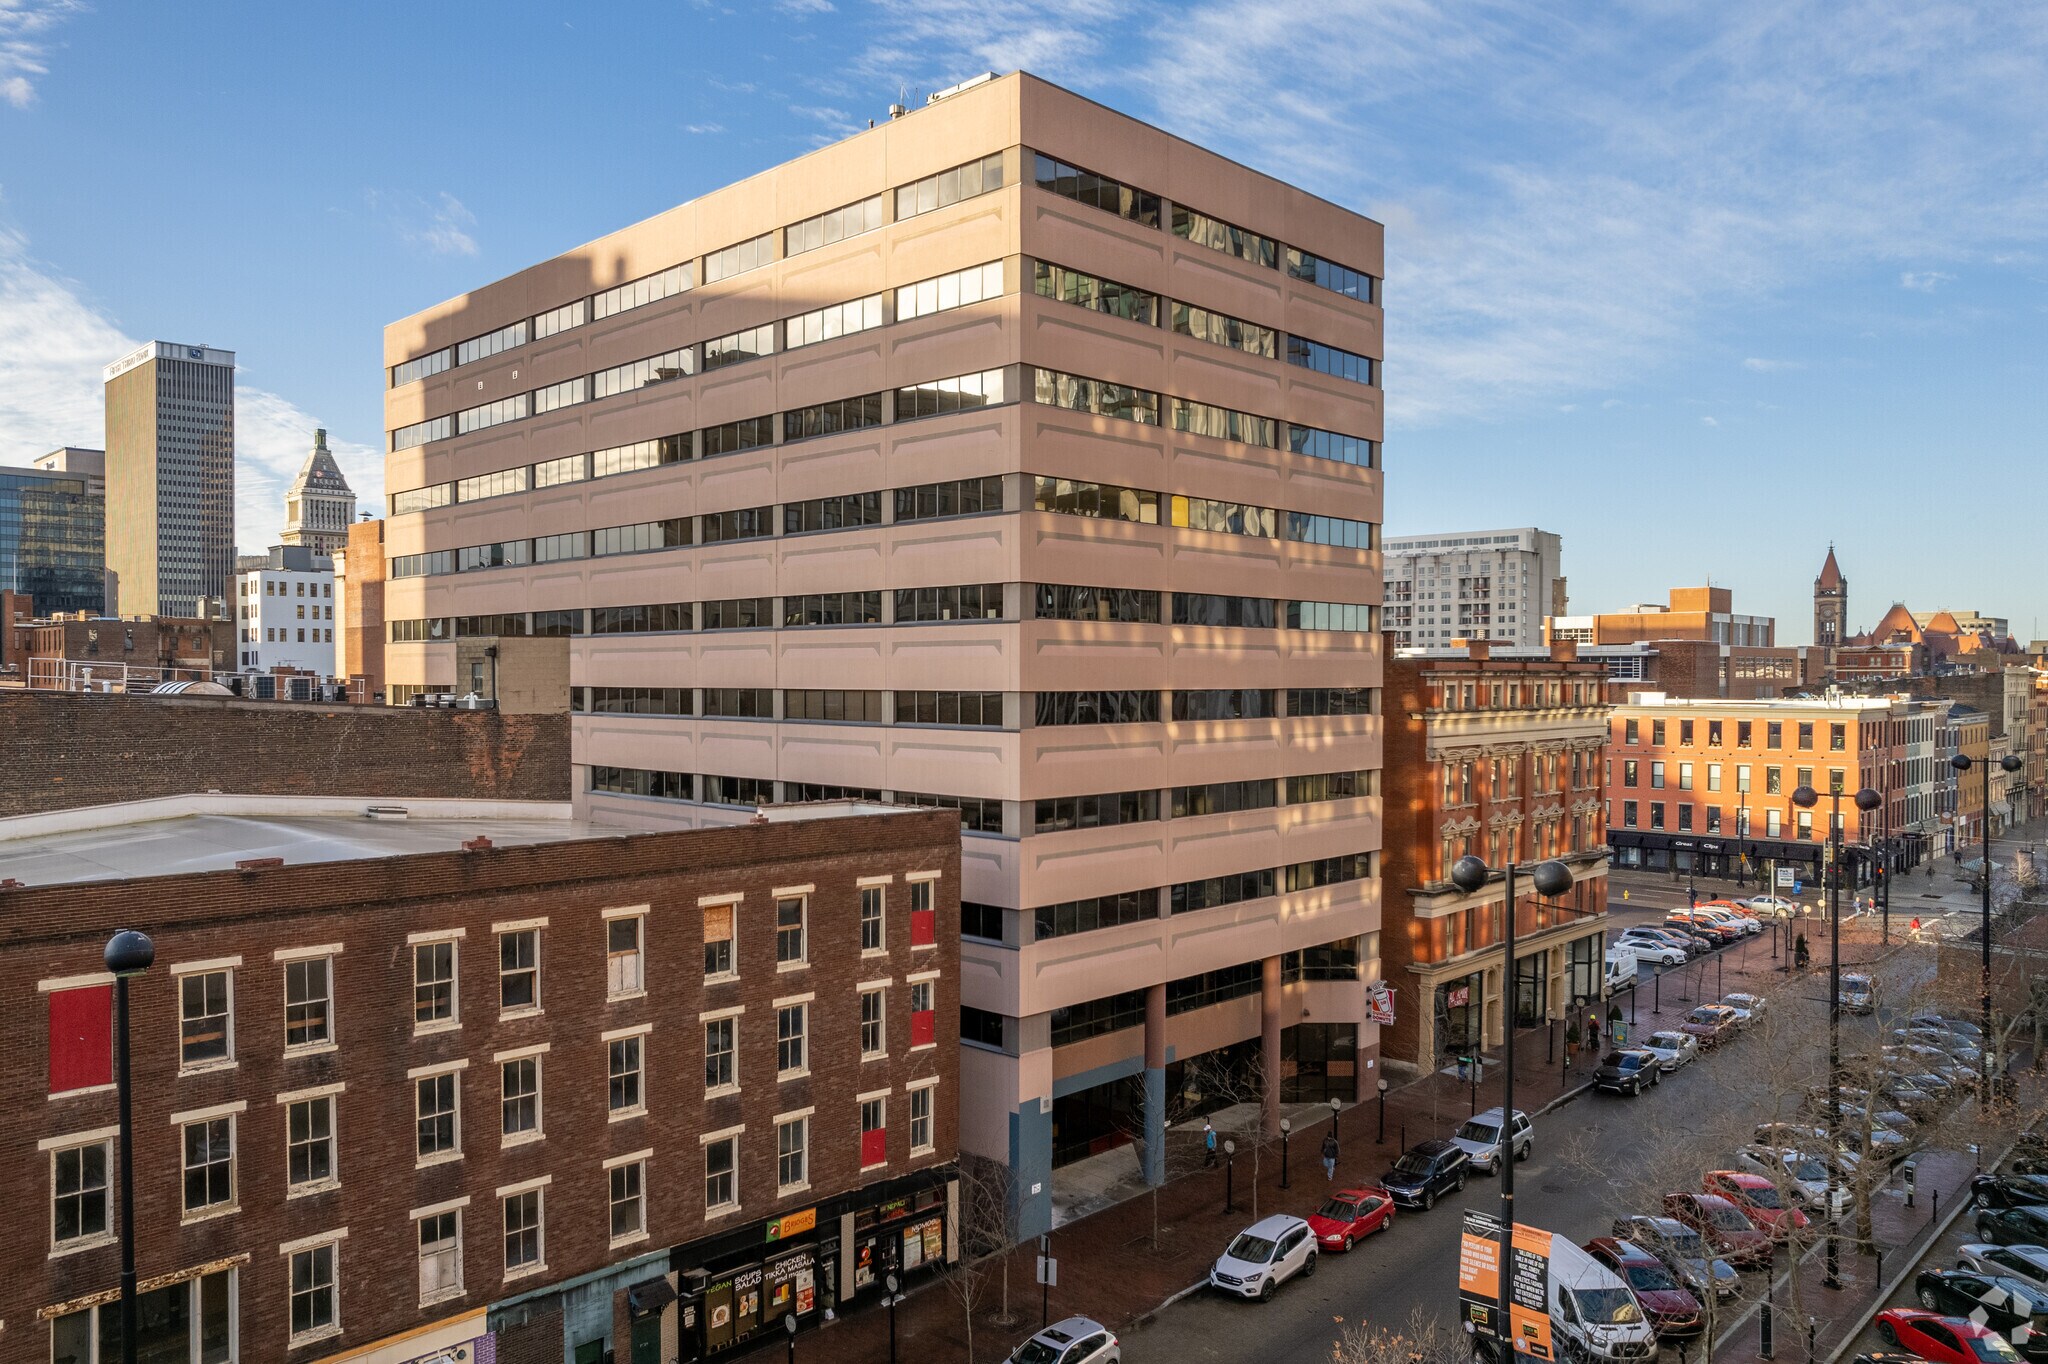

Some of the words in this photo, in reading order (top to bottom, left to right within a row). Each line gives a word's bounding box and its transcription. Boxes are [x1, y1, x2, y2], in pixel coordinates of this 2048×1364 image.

[784, 1213, 814, 1232] BRIDGES
[764, 1266, 786, 1280] TIKKA
[787, 1257, 816, 1272] MASALA
[775, 1253, 807, 1270] CHICKEN
[734, 1269, 762, 1285] SOUPS
[735, 1276, 762, 1292] SALAD
[774, 1274, 788, 1284] and
[705, 1280, 732, 1295] VEGAN
